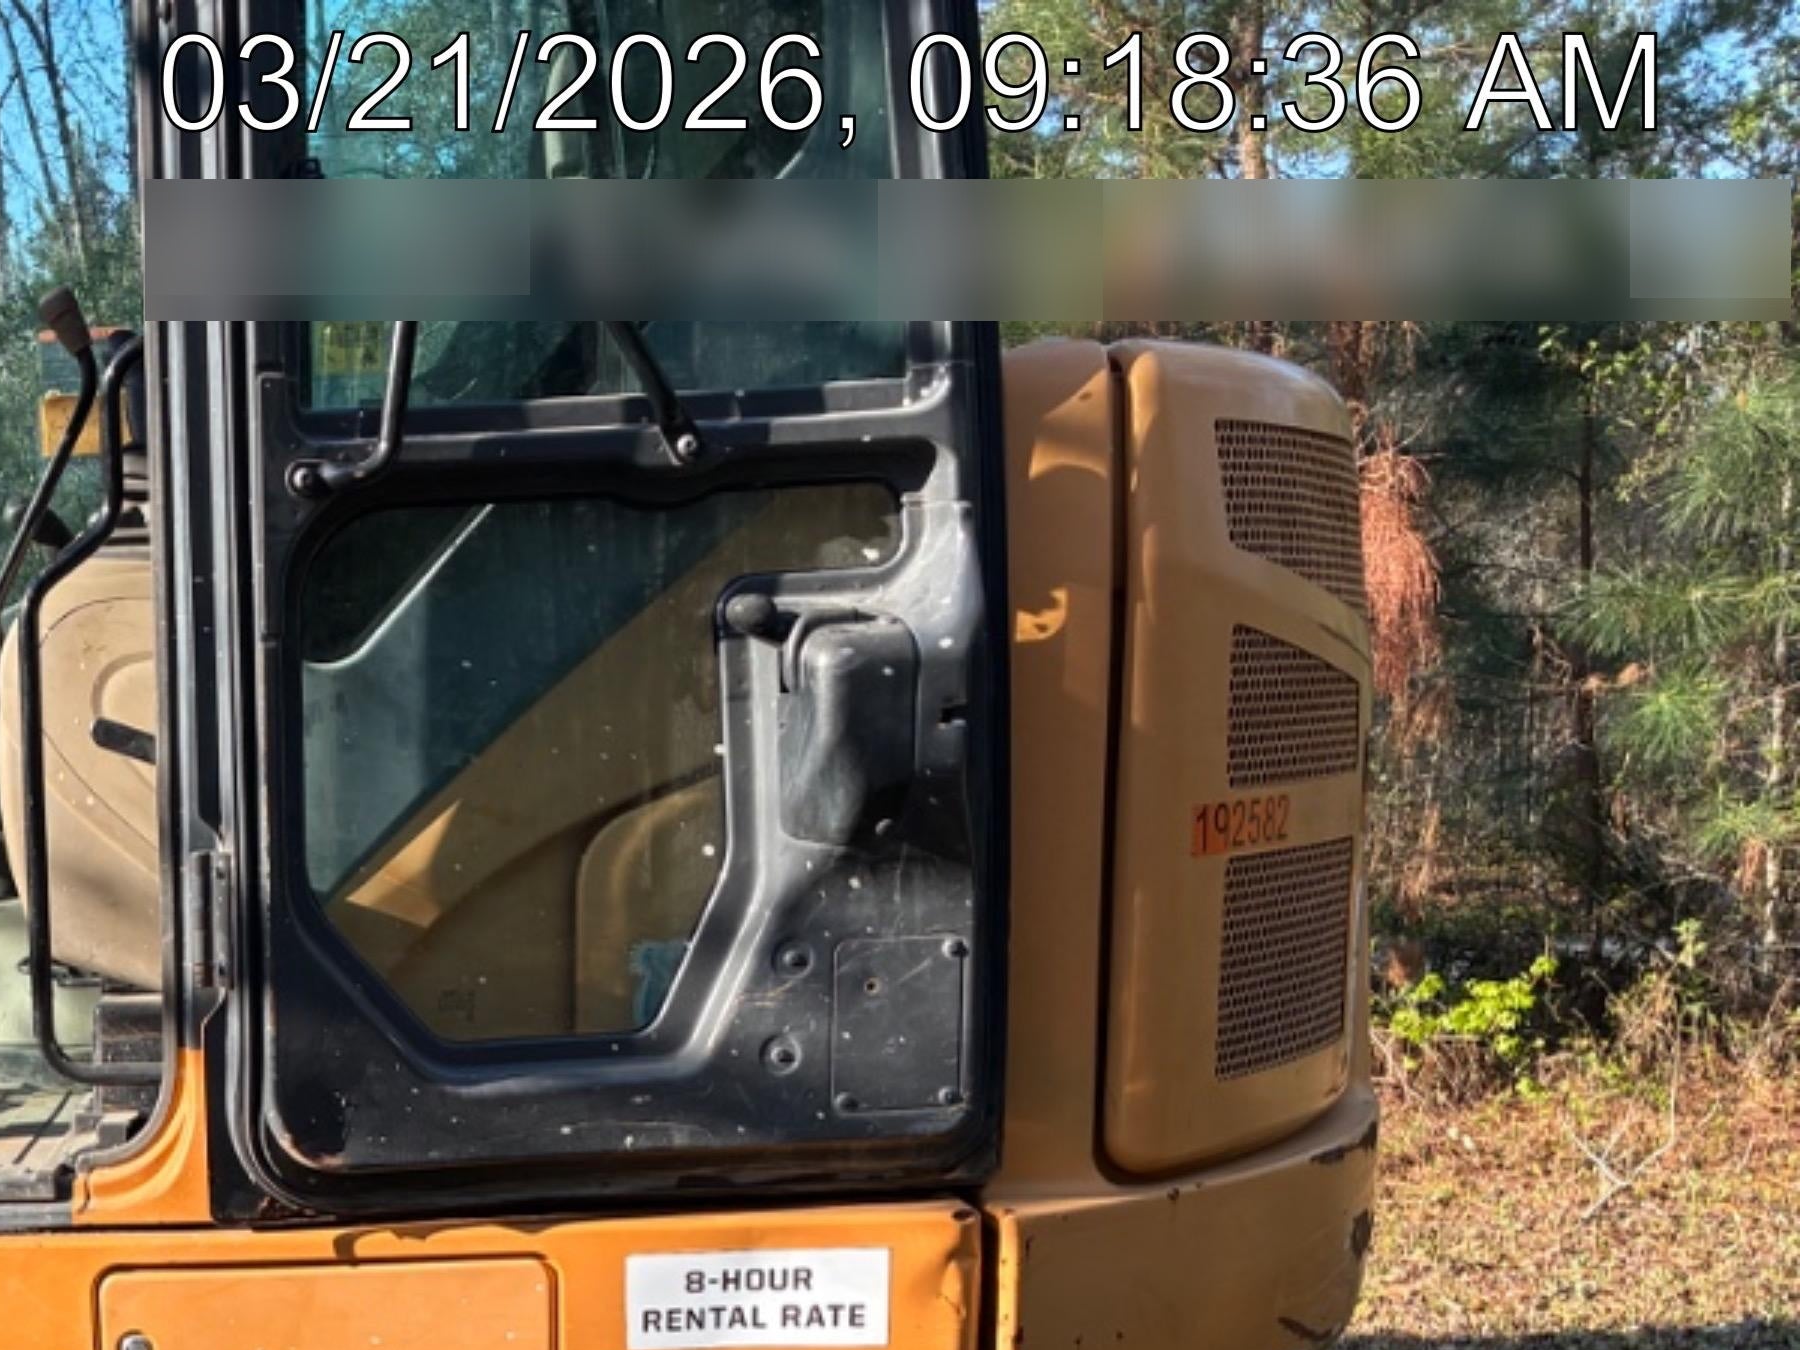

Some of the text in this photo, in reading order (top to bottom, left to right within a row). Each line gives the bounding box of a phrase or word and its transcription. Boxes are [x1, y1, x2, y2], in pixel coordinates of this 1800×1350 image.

[685, 1267, 813, 1293] 8-HOUR
[641, 1303, 866, 1332] RENTAL RATE
